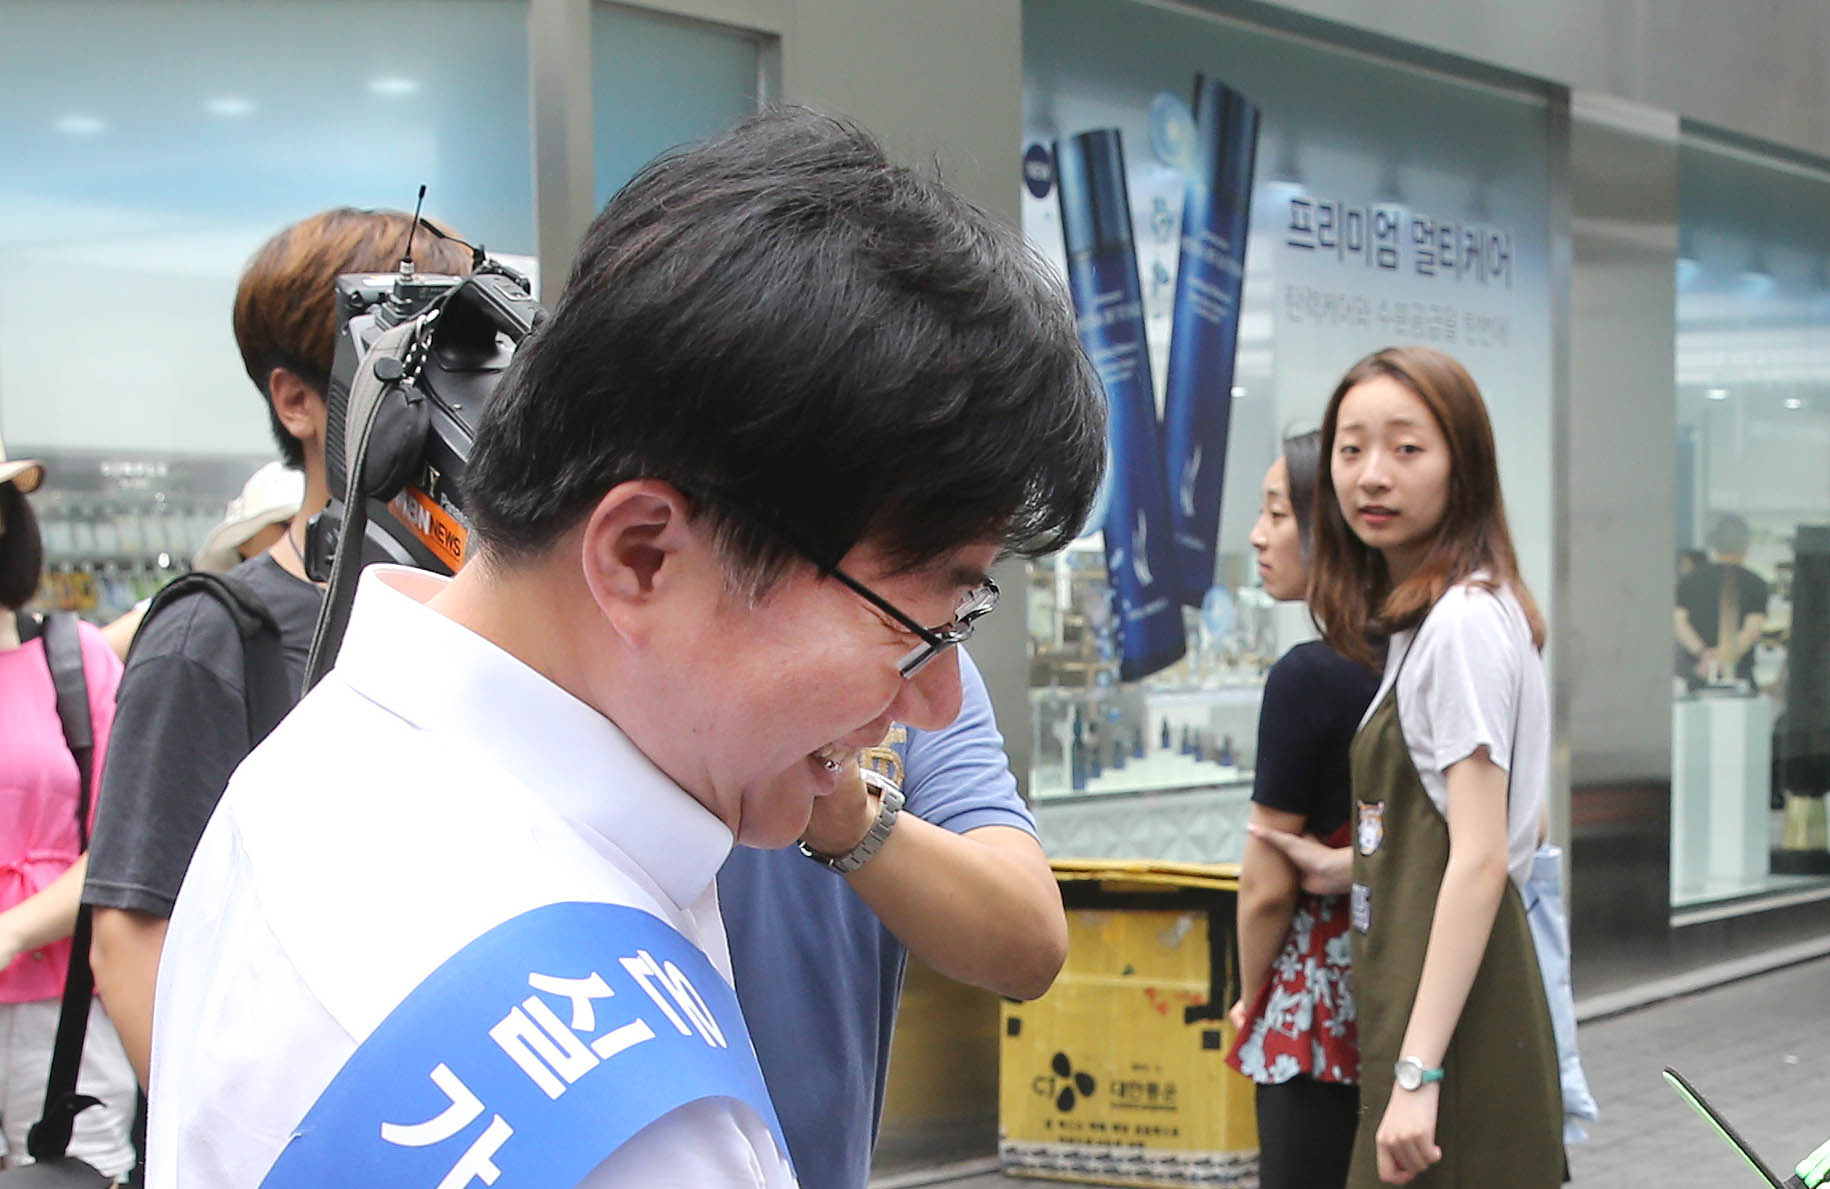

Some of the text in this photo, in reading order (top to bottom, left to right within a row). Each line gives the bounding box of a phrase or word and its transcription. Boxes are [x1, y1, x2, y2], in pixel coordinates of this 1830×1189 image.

[1287, 198, 1514, 290] 프리미엄 멀티케어
[430, 514, 462, 558] NEWS
